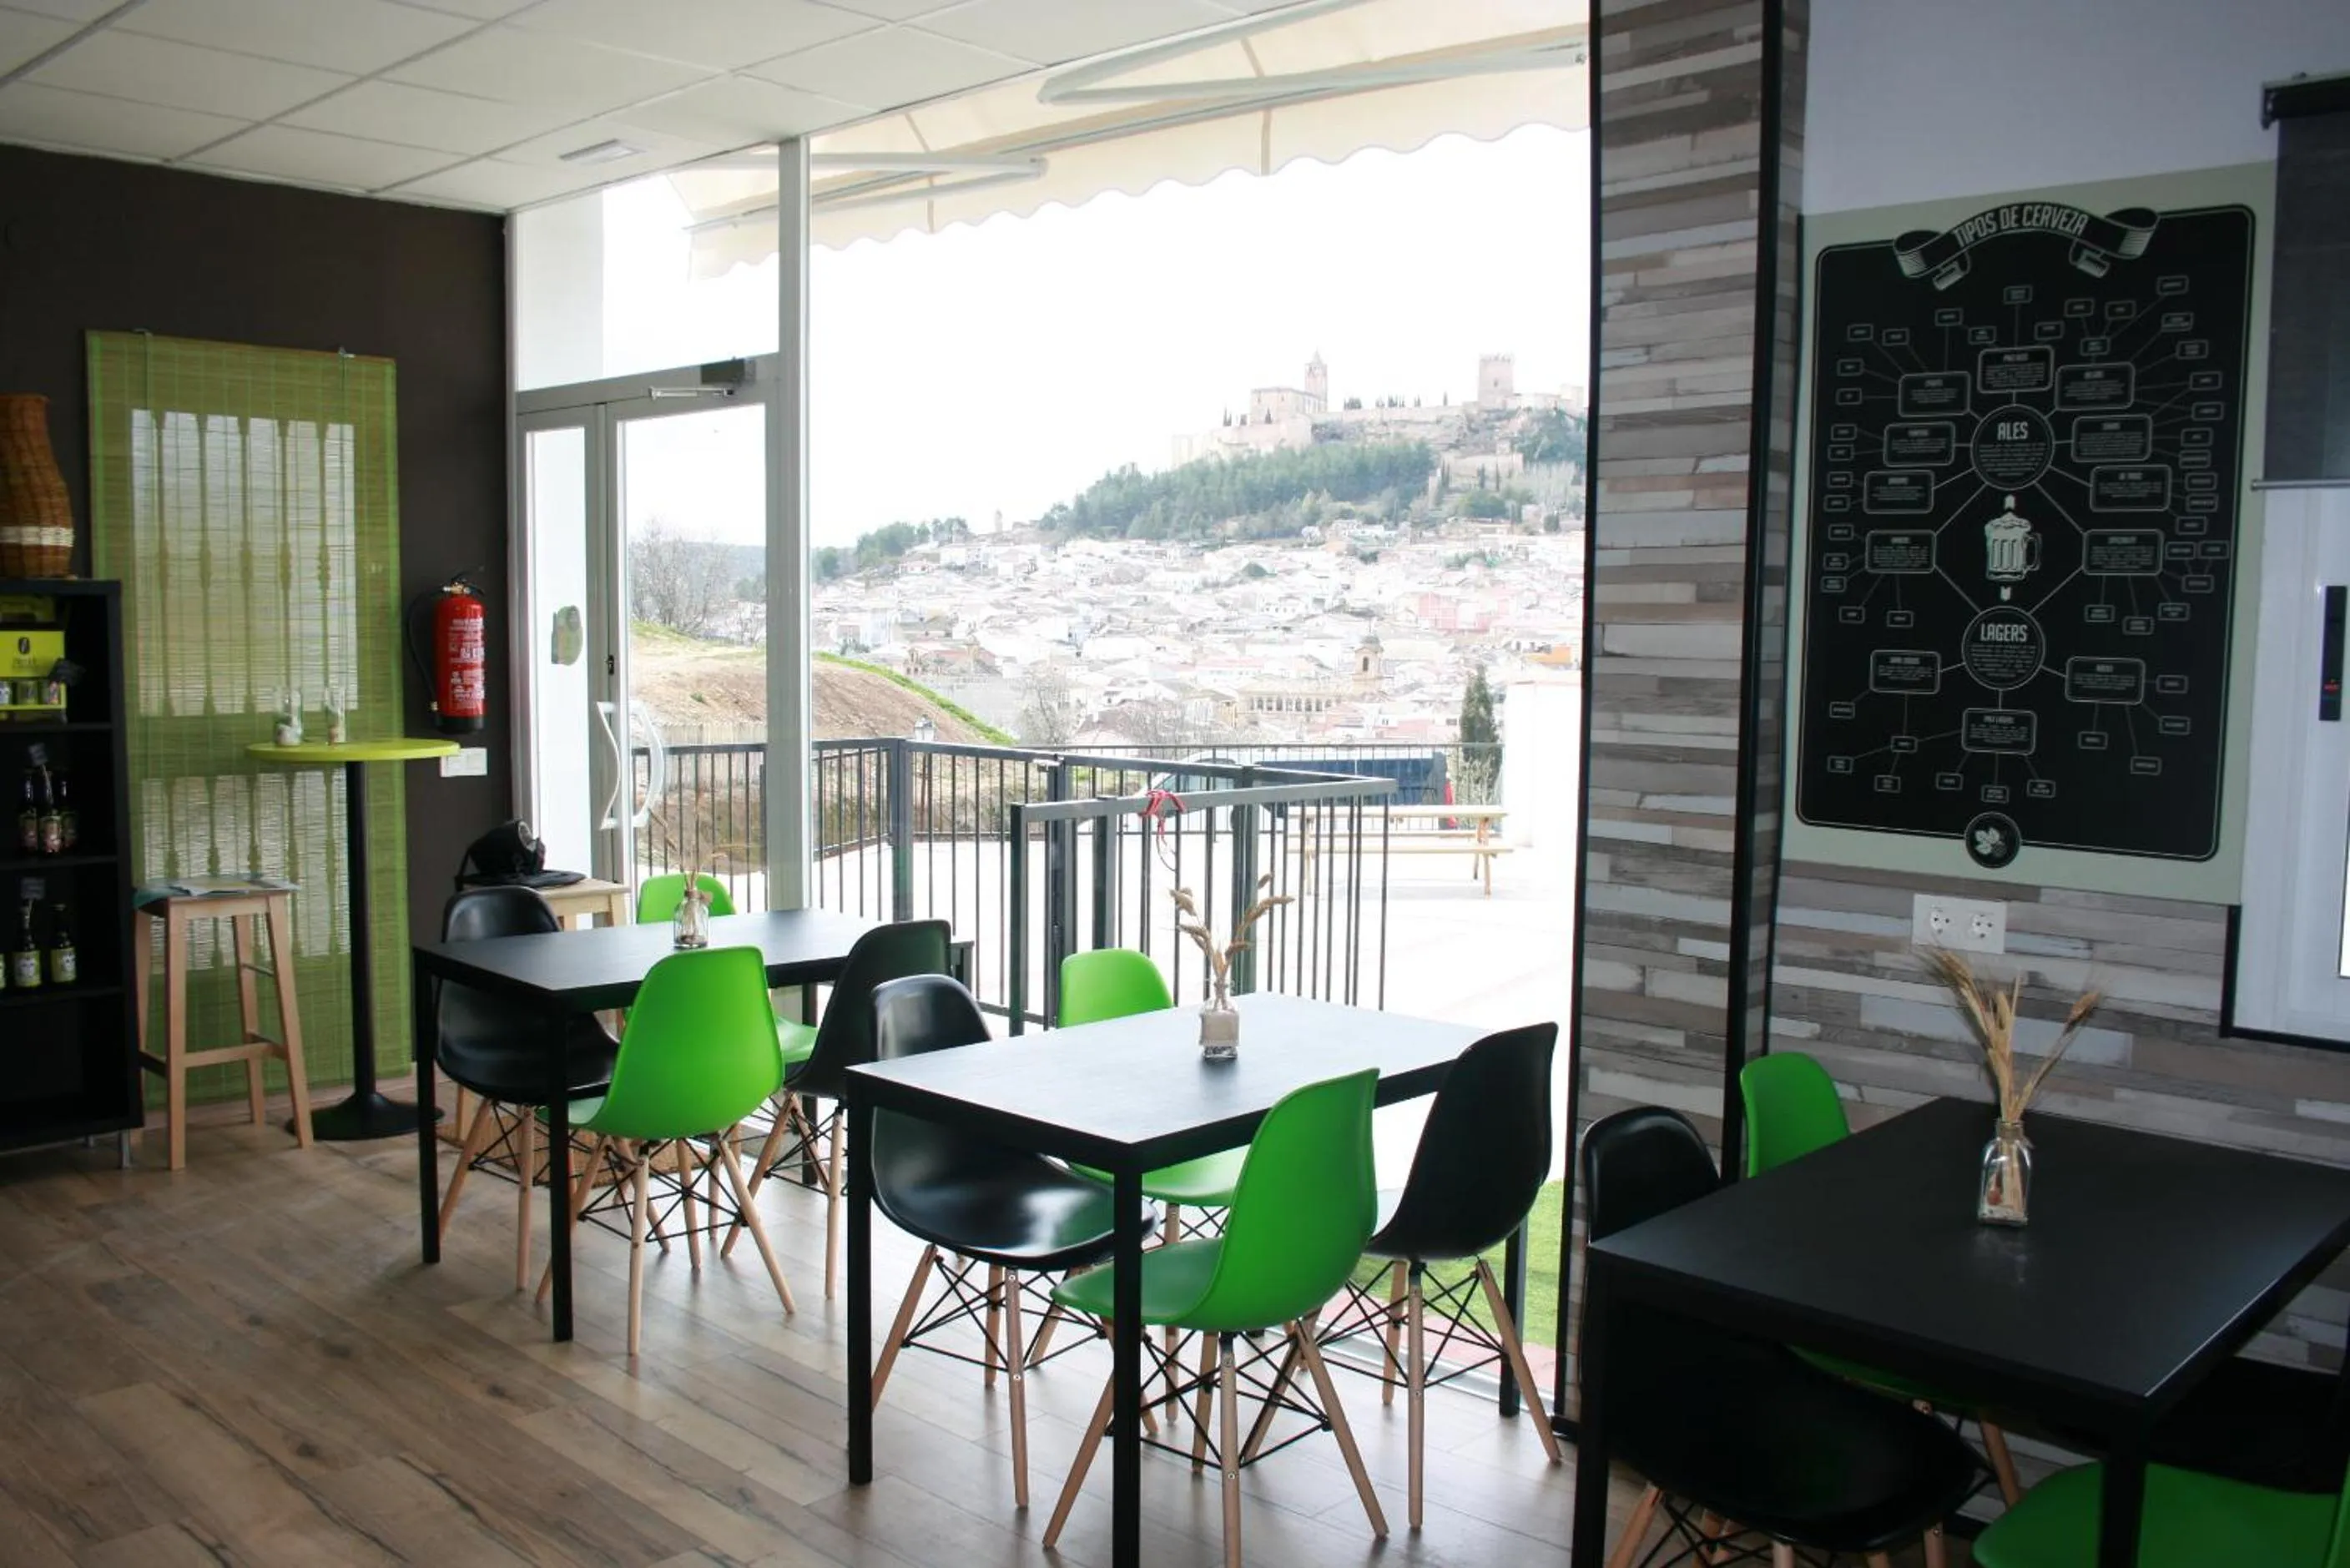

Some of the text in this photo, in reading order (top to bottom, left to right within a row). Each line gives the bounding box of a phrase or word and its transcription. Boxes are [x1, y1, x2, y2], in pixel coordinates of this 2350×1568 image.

[1953, 204, 2088, 248] TIPOS DE CERVEZA
[1997, 421, 2029, 441] ALES
[1980, 622, 2028, 642] LAGERS
